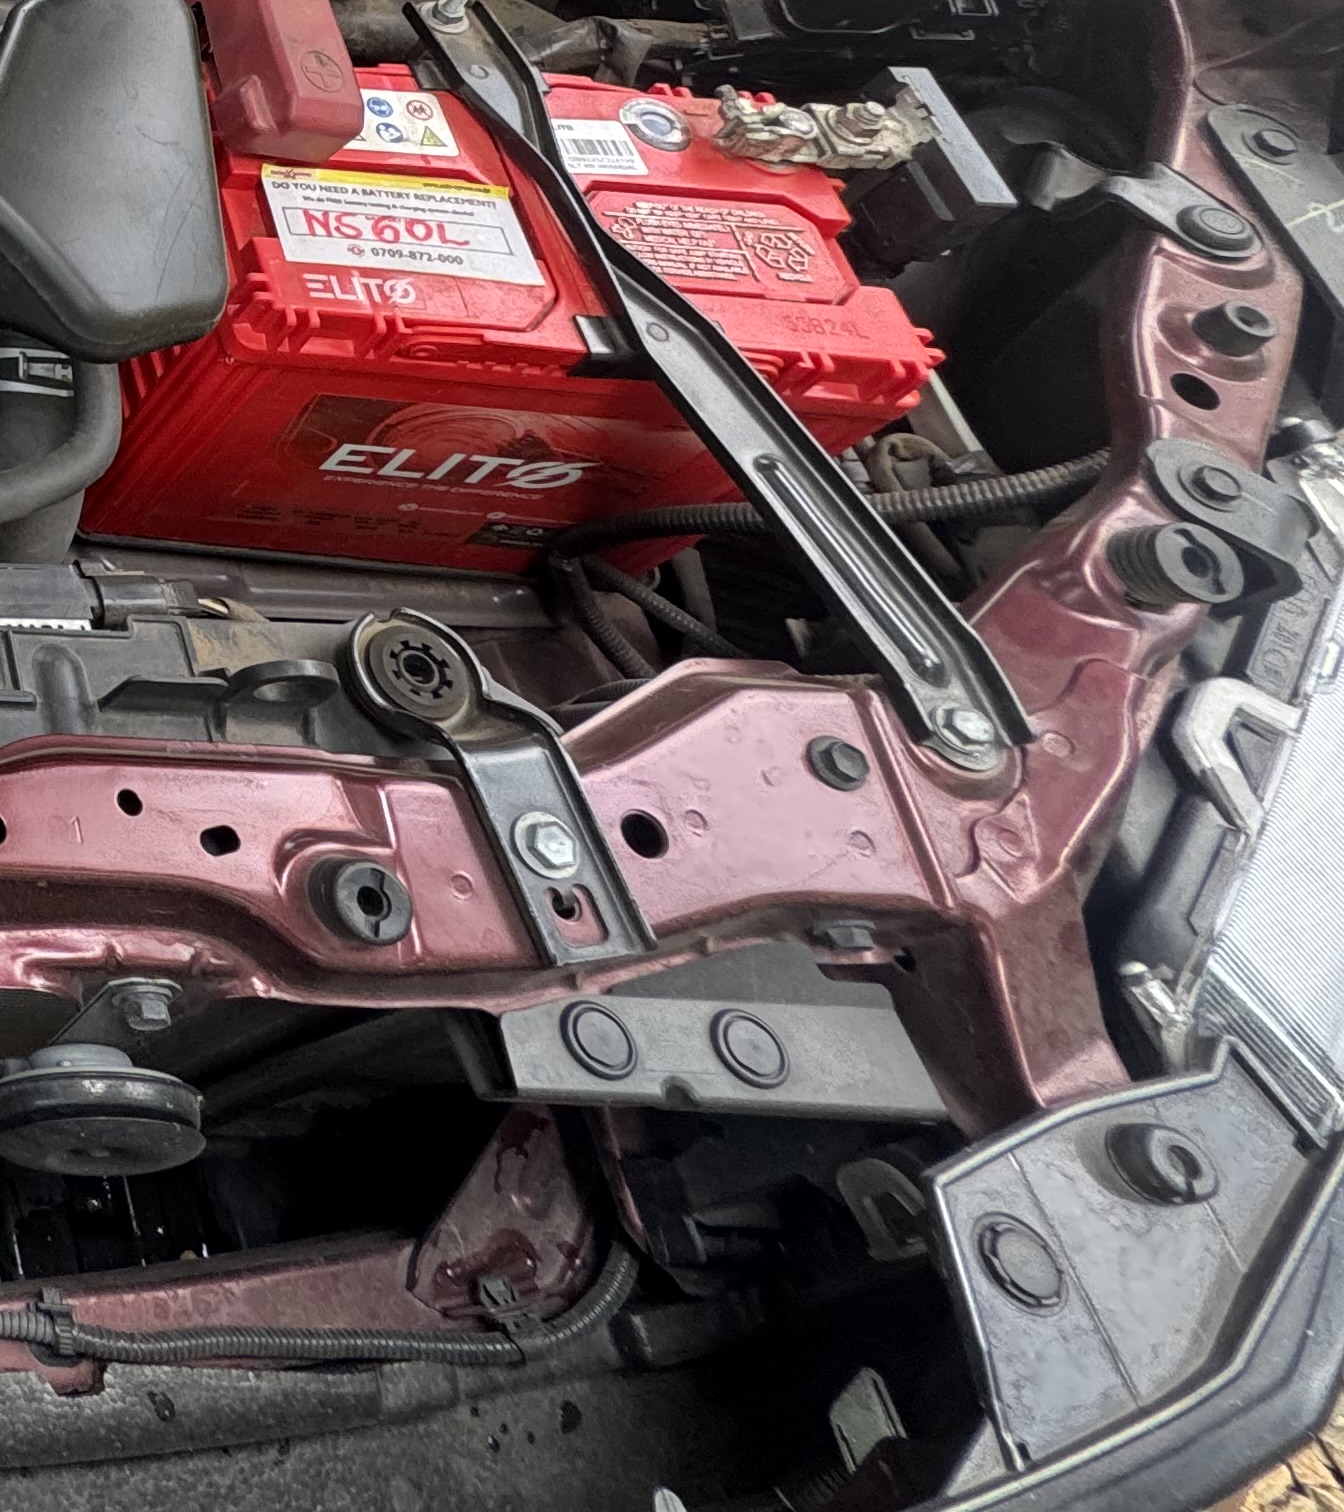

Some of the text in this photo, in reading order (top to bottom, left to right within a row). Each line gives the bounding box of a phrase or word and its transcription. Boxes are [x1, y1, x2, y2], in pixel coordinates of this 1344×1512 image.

[272, 180, 496, 210] DO YOU NEED A BATTERY REPLACEMENT?
[371, 247, 463, 265] 0709-872-000
